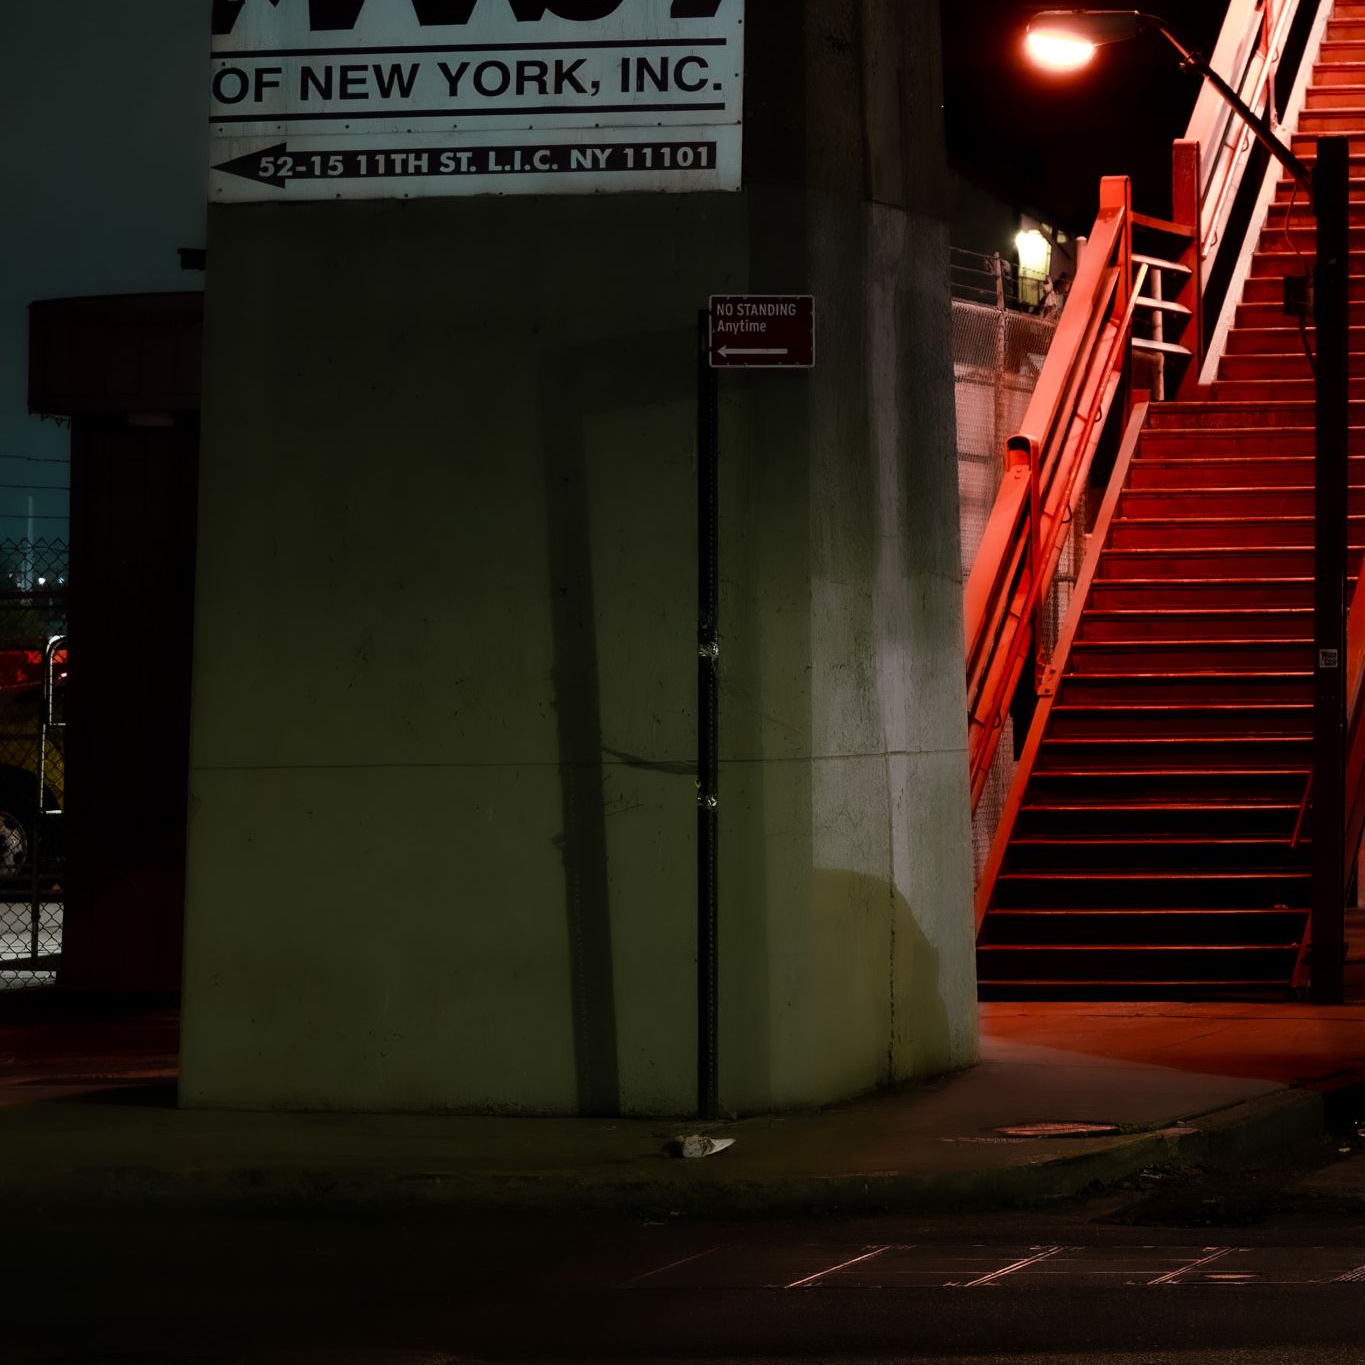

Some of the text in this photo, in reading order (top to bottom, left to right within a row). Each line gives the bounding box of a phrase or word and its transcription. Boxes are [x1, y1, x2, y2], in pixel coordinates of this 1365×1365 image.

[212, 56, 723, 105] OF NEW YORK, INC.
[258, 144, 710, 178] 52-15 11TH ST. L.I.C. NY 11101
[716, 303, 797, 316] NO STANDING
[717, 319, 768, 335] Anytime
